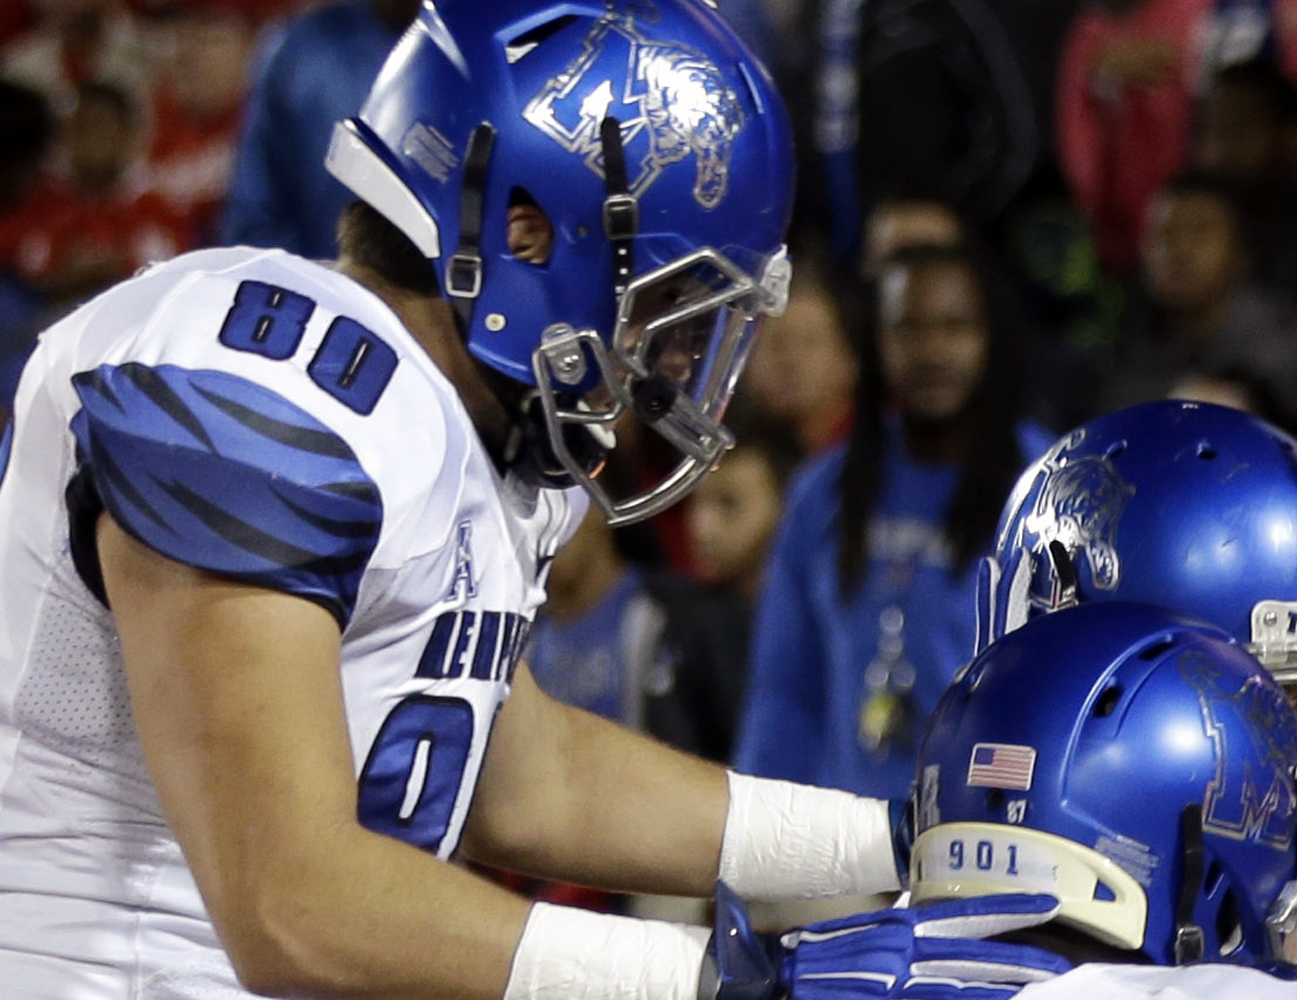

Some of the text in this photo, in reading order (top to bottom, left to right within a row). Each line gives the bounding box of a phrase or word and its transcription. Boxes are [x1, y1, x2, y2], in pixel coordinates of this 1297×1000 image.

[218, 278, 399, 417] 80
[1007, 799, 1028, 824] 87
[949, 838, 1019, 877] 901
